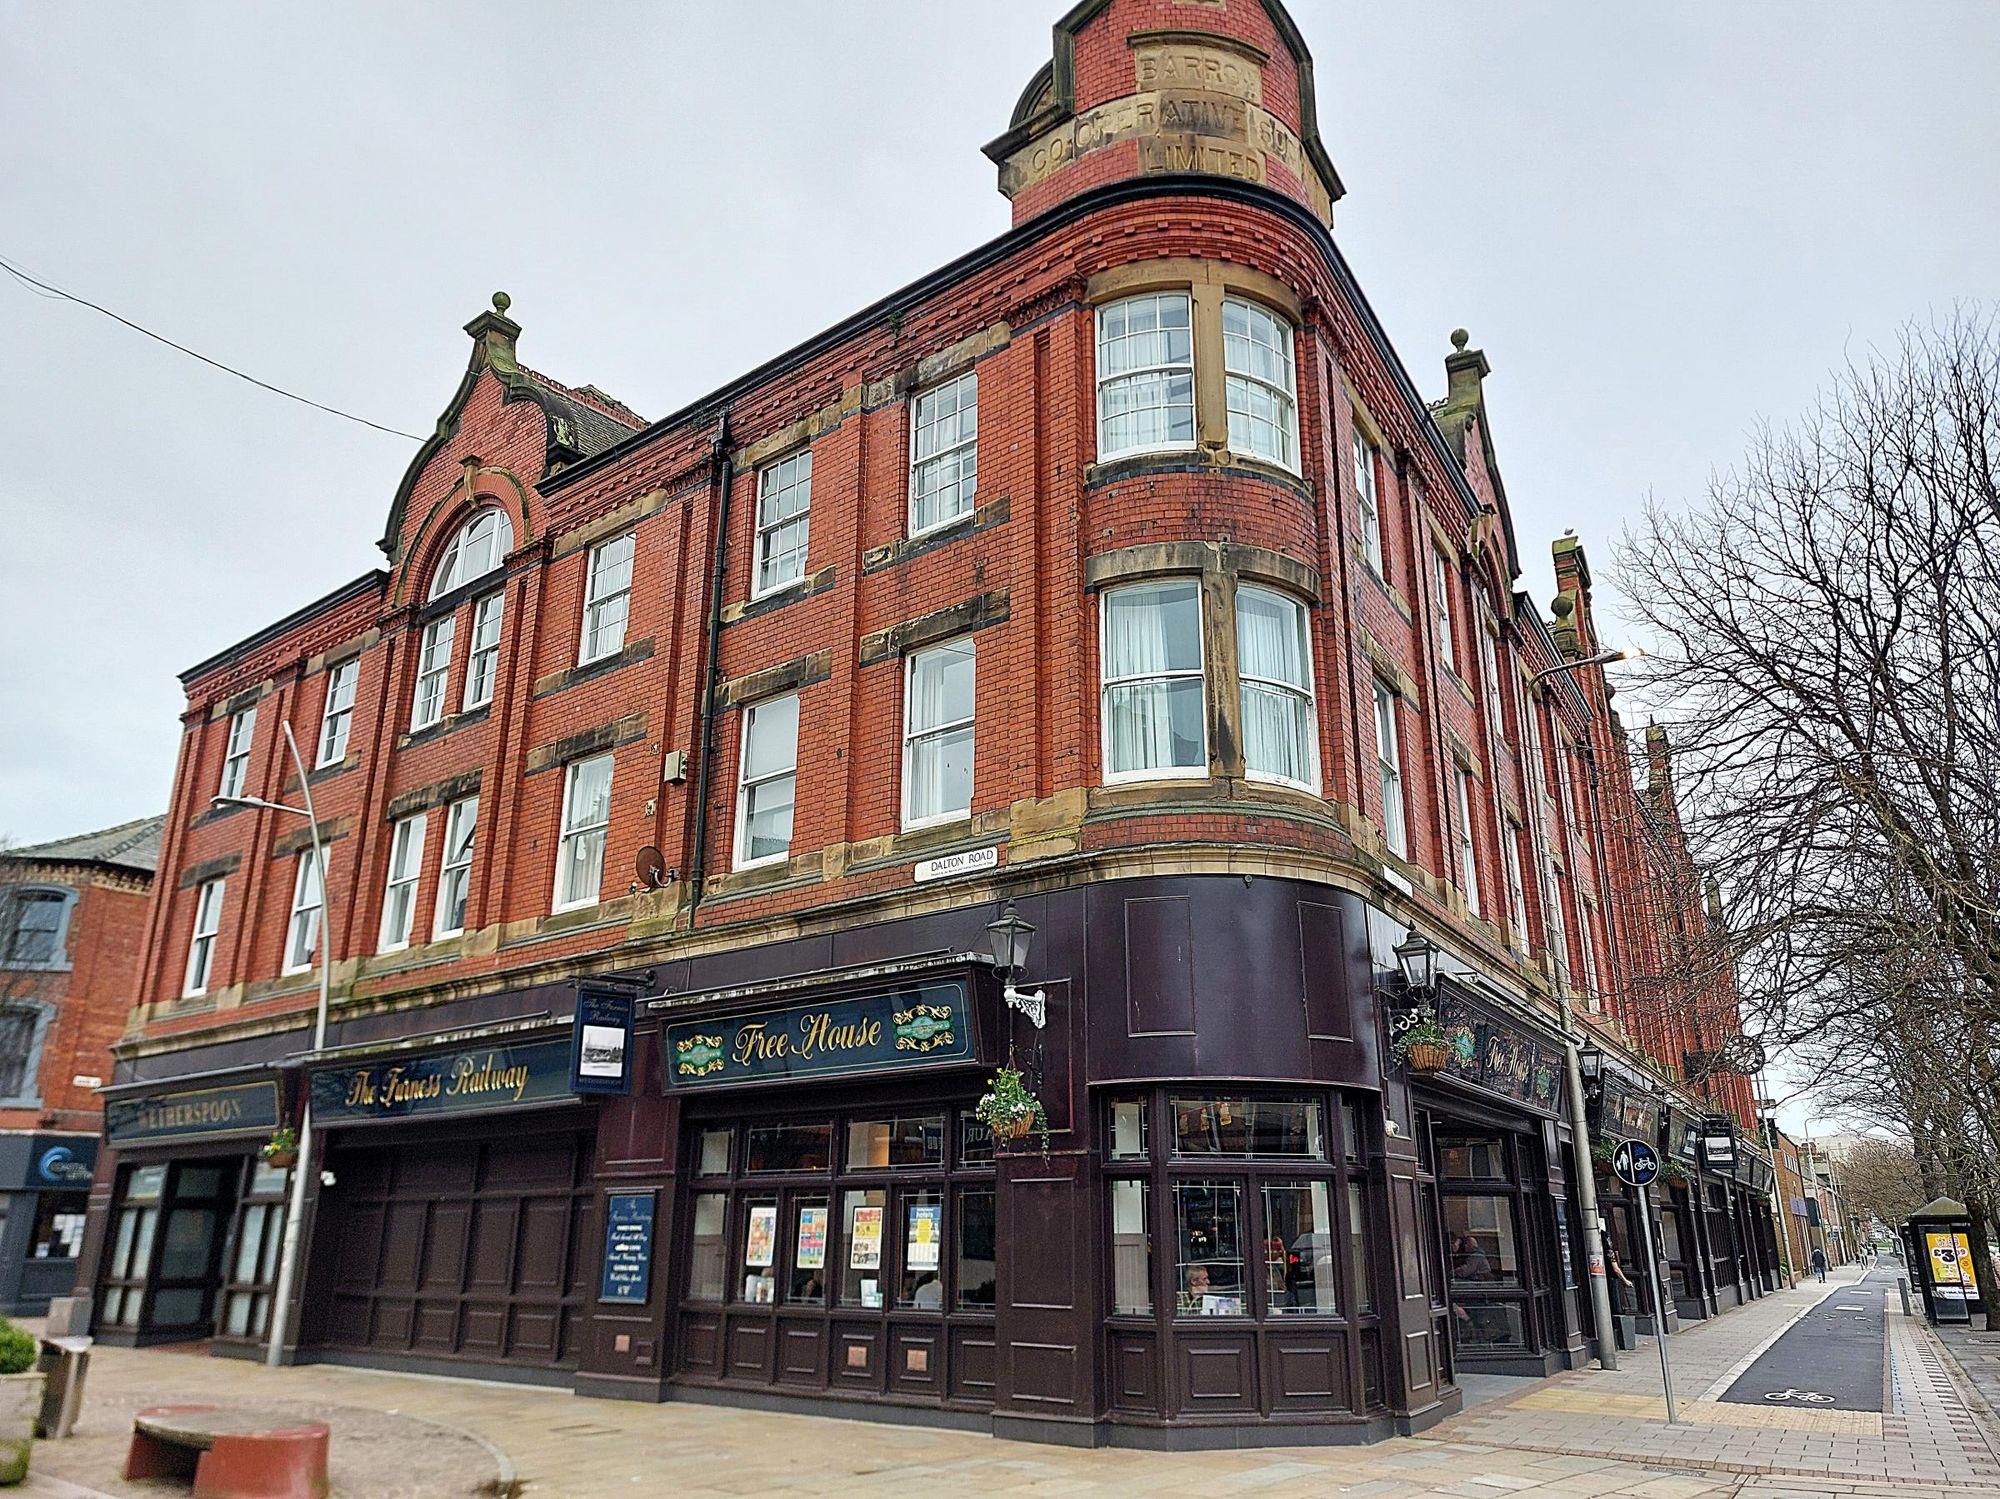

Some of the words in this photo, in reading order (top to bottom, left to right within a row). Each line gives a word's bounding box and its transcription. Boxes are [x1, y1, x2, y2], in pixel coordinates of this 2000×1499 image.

[1145, 145, 1262, 184] LIMITED
[931, 855, 964, 872] DALTON
[968, 849, 994, 864] ROAD
[732, 1020, 789, 1067] Free
[791, 1012, 882, 1060] House
[345, 1070, 376, 1106] The
[379, 1066, 442, 1108] Furness
[446, 1053, 528, 1102] Railway
